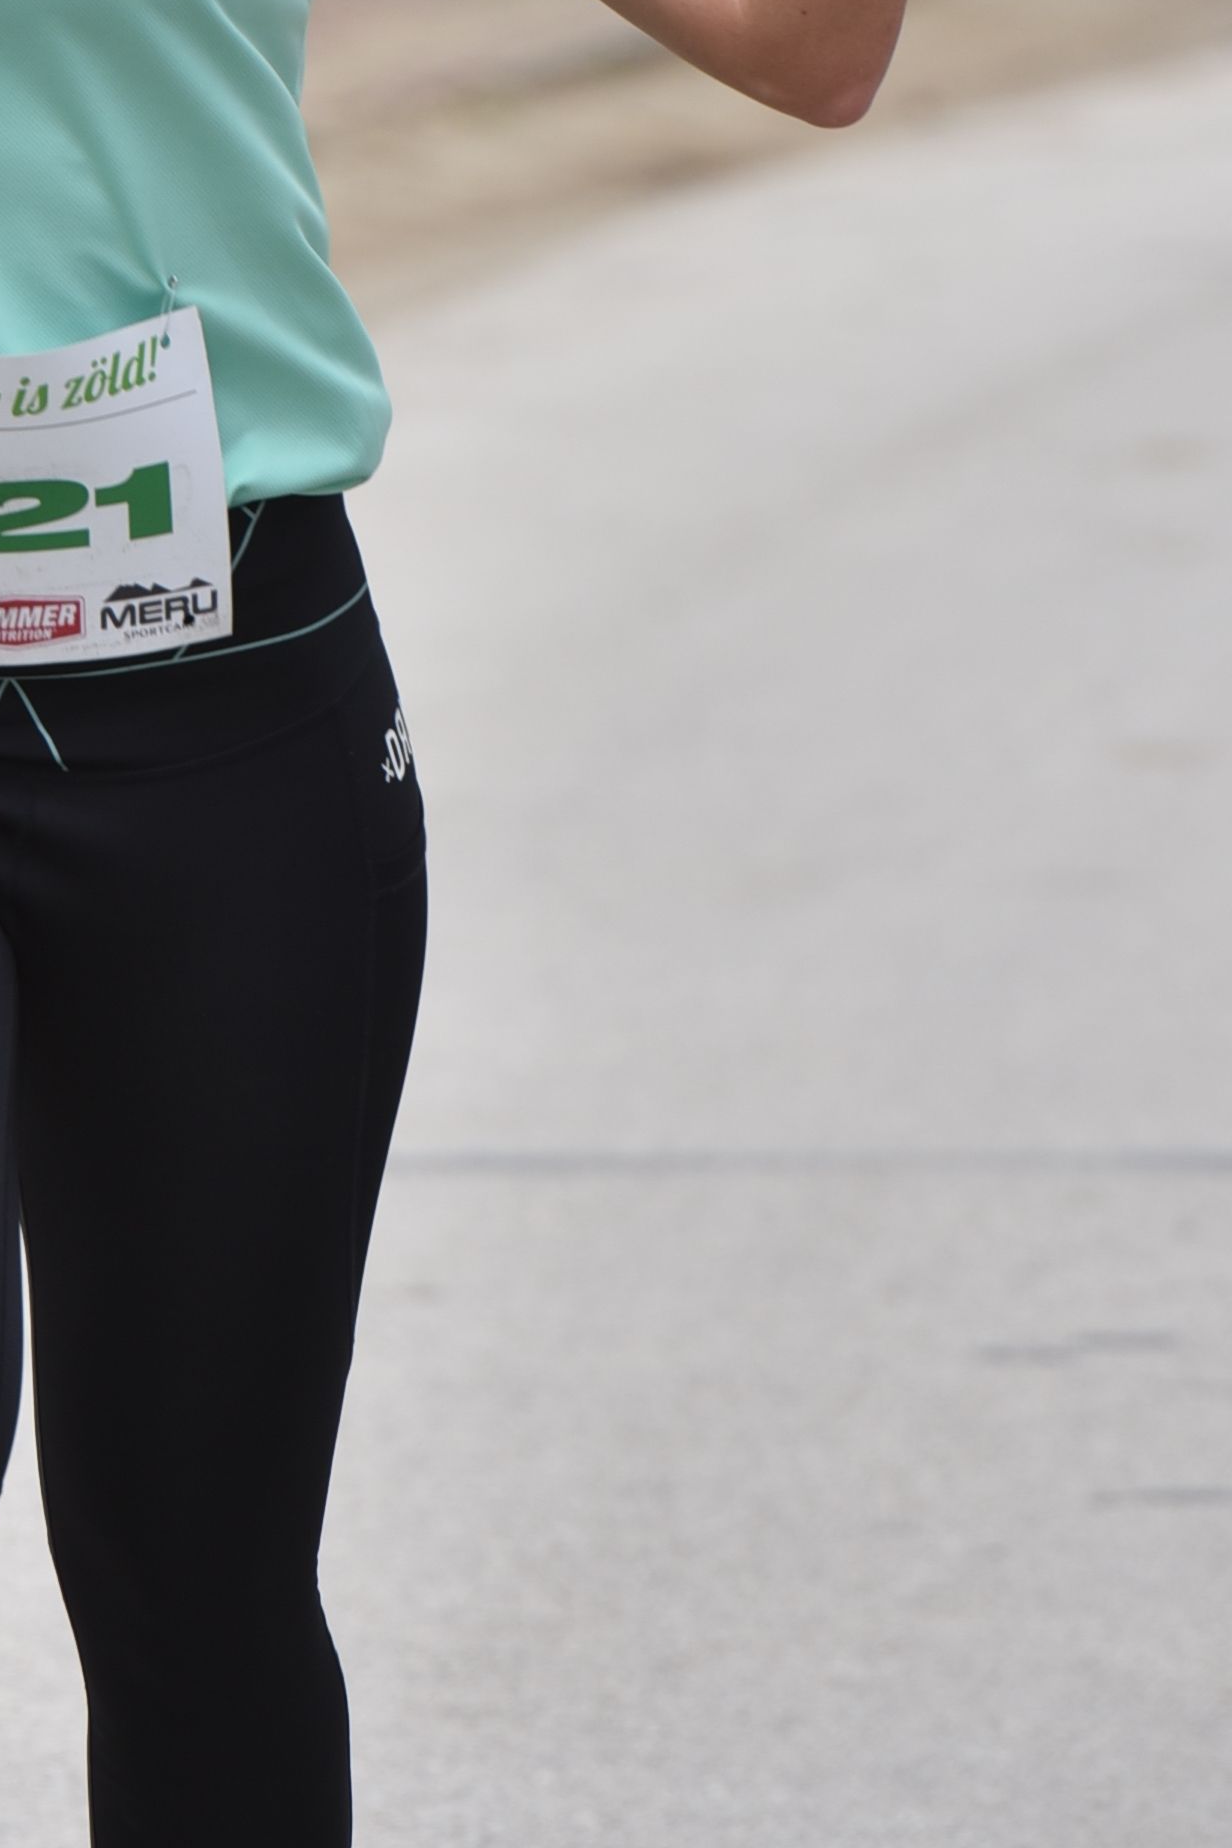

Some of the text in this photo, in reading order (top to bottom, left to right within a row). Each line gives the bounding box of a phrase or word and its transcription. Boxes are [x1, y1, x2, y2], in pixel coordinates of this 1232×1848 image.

[11, 377, 49, 418] is
[61, 335, 158, 411] zöld!
[100, 589, 218, 631] MERU
